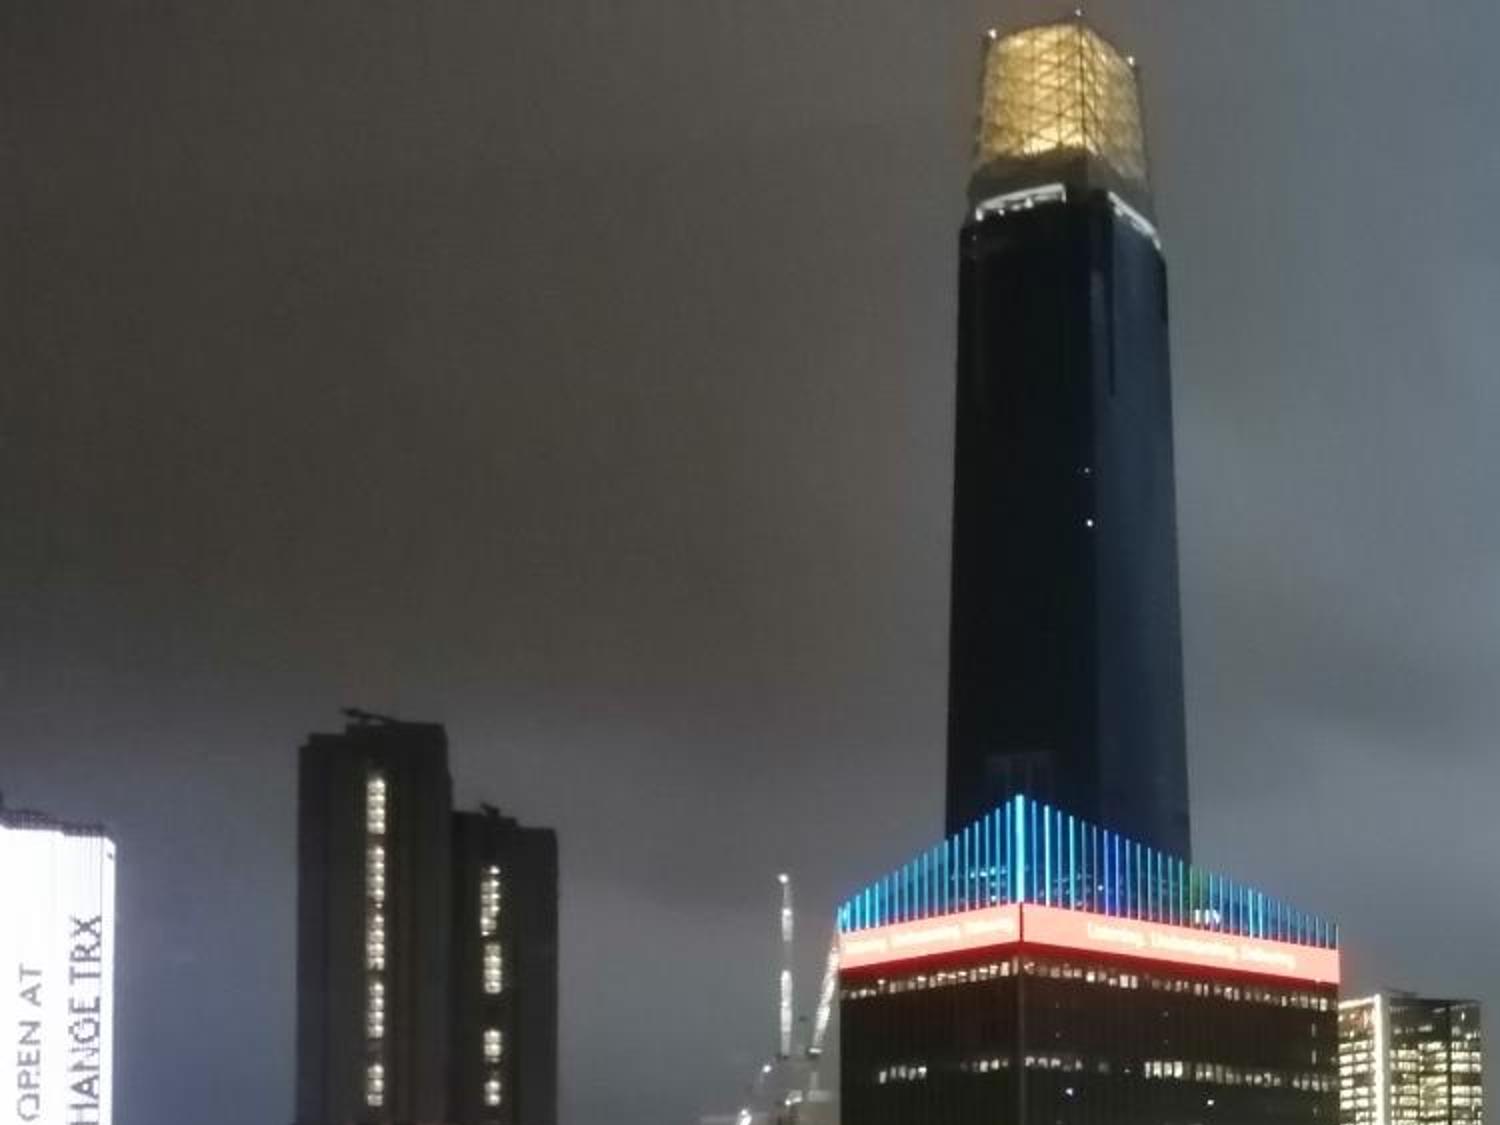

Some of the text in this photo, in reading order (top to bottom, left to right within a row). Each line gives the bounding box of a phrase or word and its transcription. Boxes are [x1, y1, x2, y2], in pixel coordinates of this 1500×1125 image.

[18, 962, 42, 1008] AT
[69, 914, 102, 987] TRX
[17, 1020, 41, 1123] OPEN
